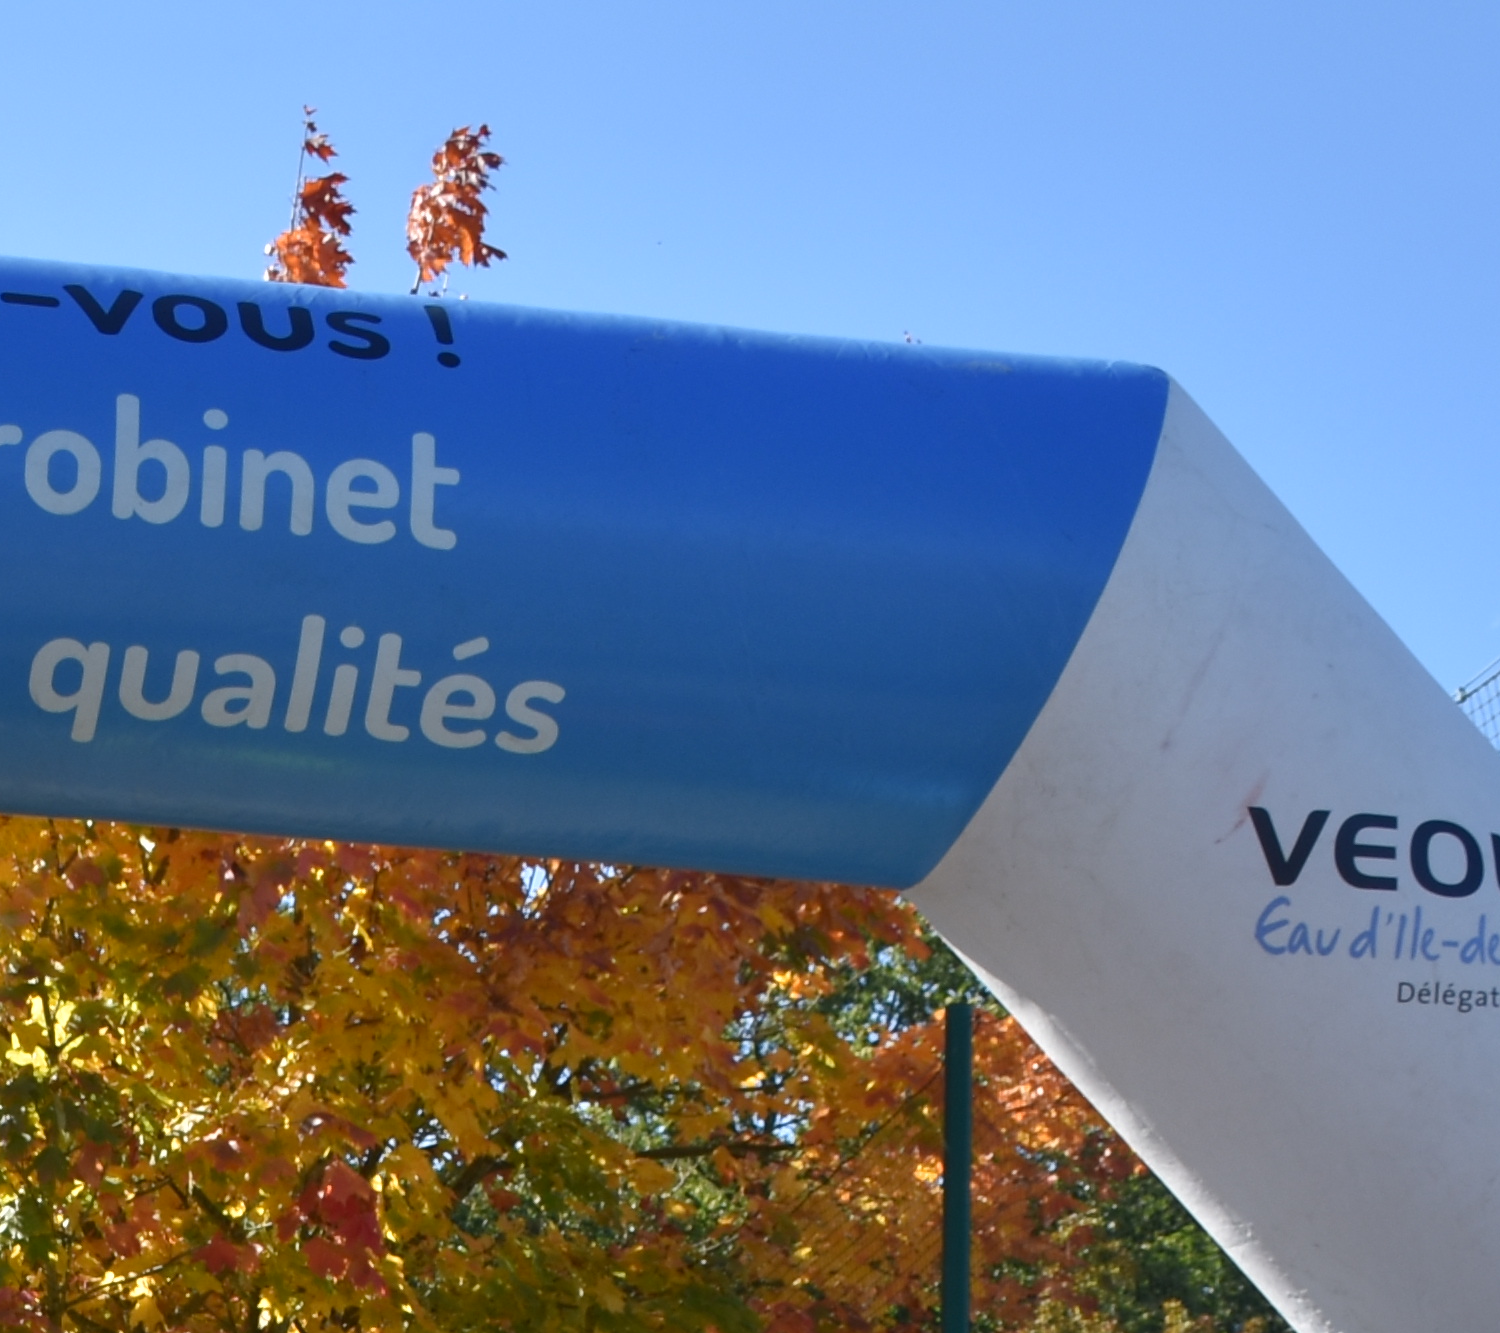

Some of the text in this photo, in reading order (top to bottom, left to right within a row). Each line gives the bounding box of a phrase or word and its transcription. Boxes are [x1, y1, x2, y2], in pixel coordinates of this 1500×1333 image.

[423, 303, 464, 370] !
[26, 614, 567, 755] qualités
[1254, 895, 1341, 958] Eau
